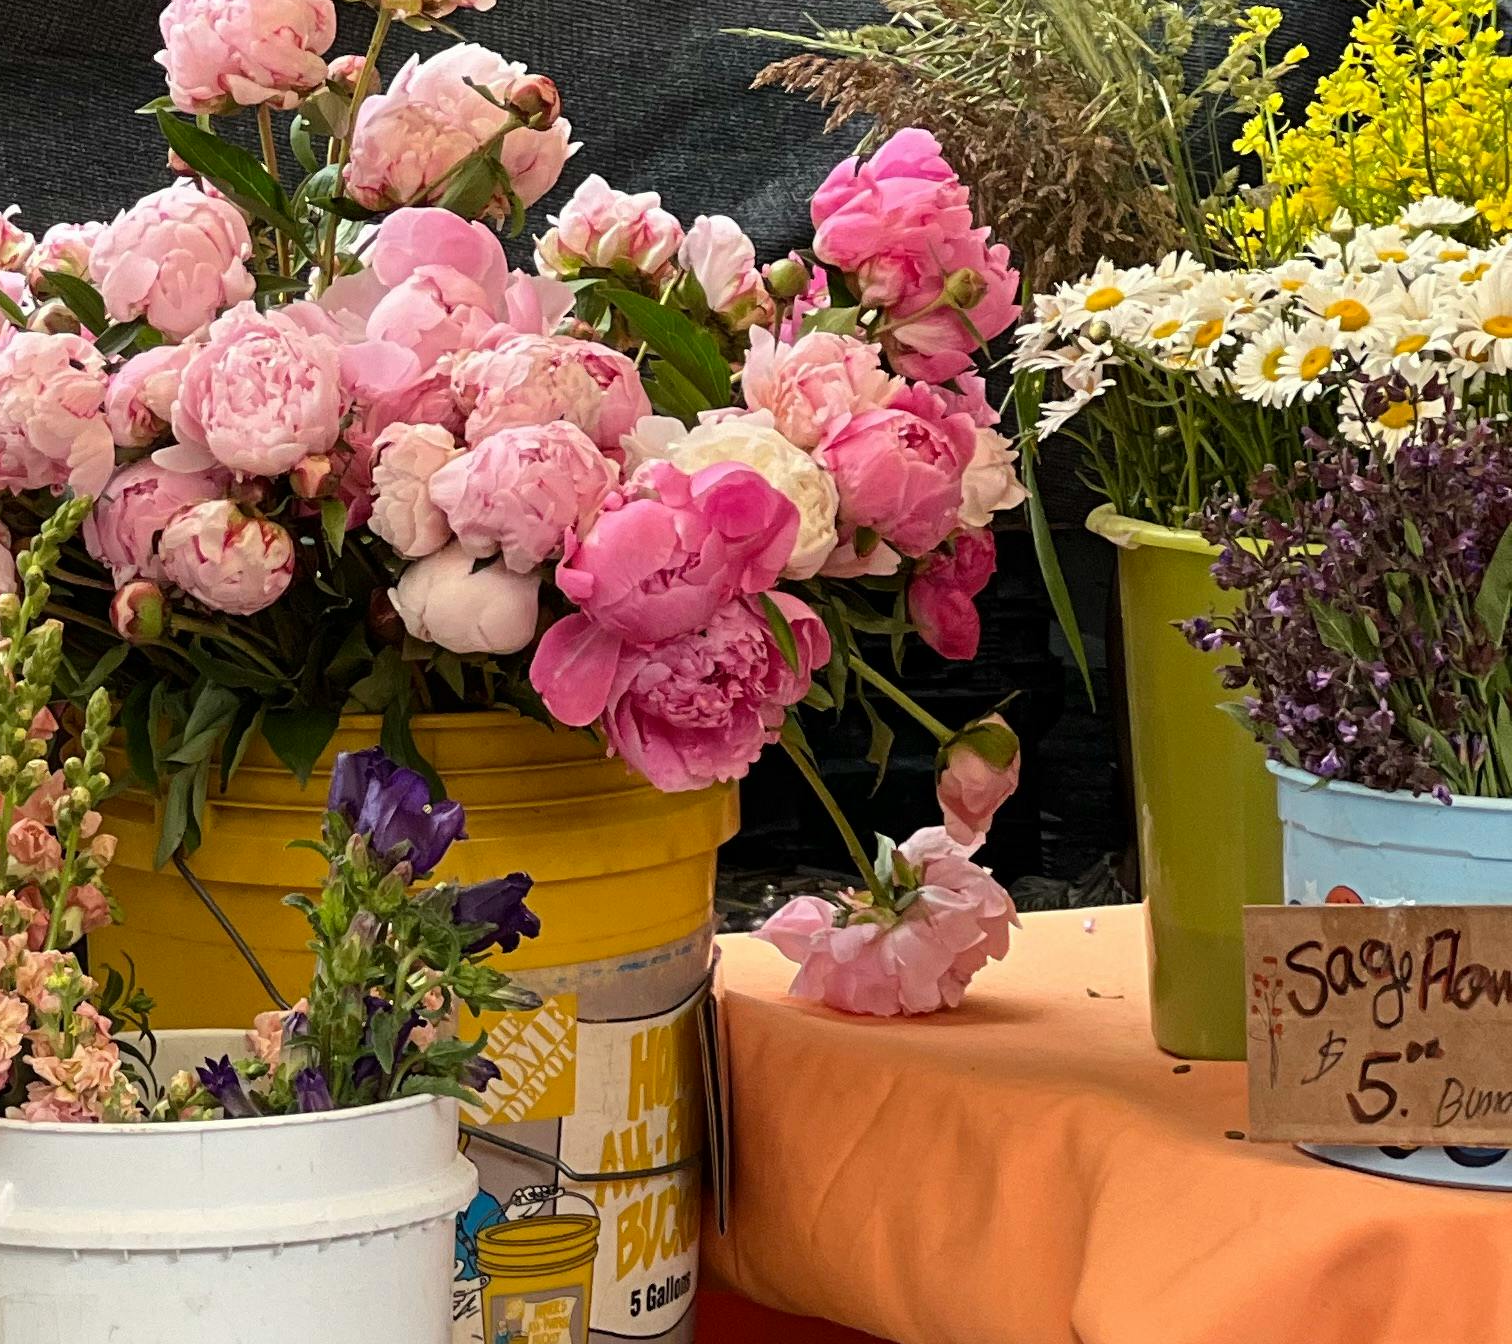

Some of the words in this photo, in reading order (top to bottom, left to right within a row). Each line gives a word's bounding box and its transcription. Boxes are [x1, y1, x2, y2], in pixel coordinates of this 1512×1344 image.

[1285, 939, 1414, 1030] Sage
[458, 996, 575, 1126] HOME
[502, 1038, 575, 1123] DEPOT
[630, 1288, 642, 1317] 5
